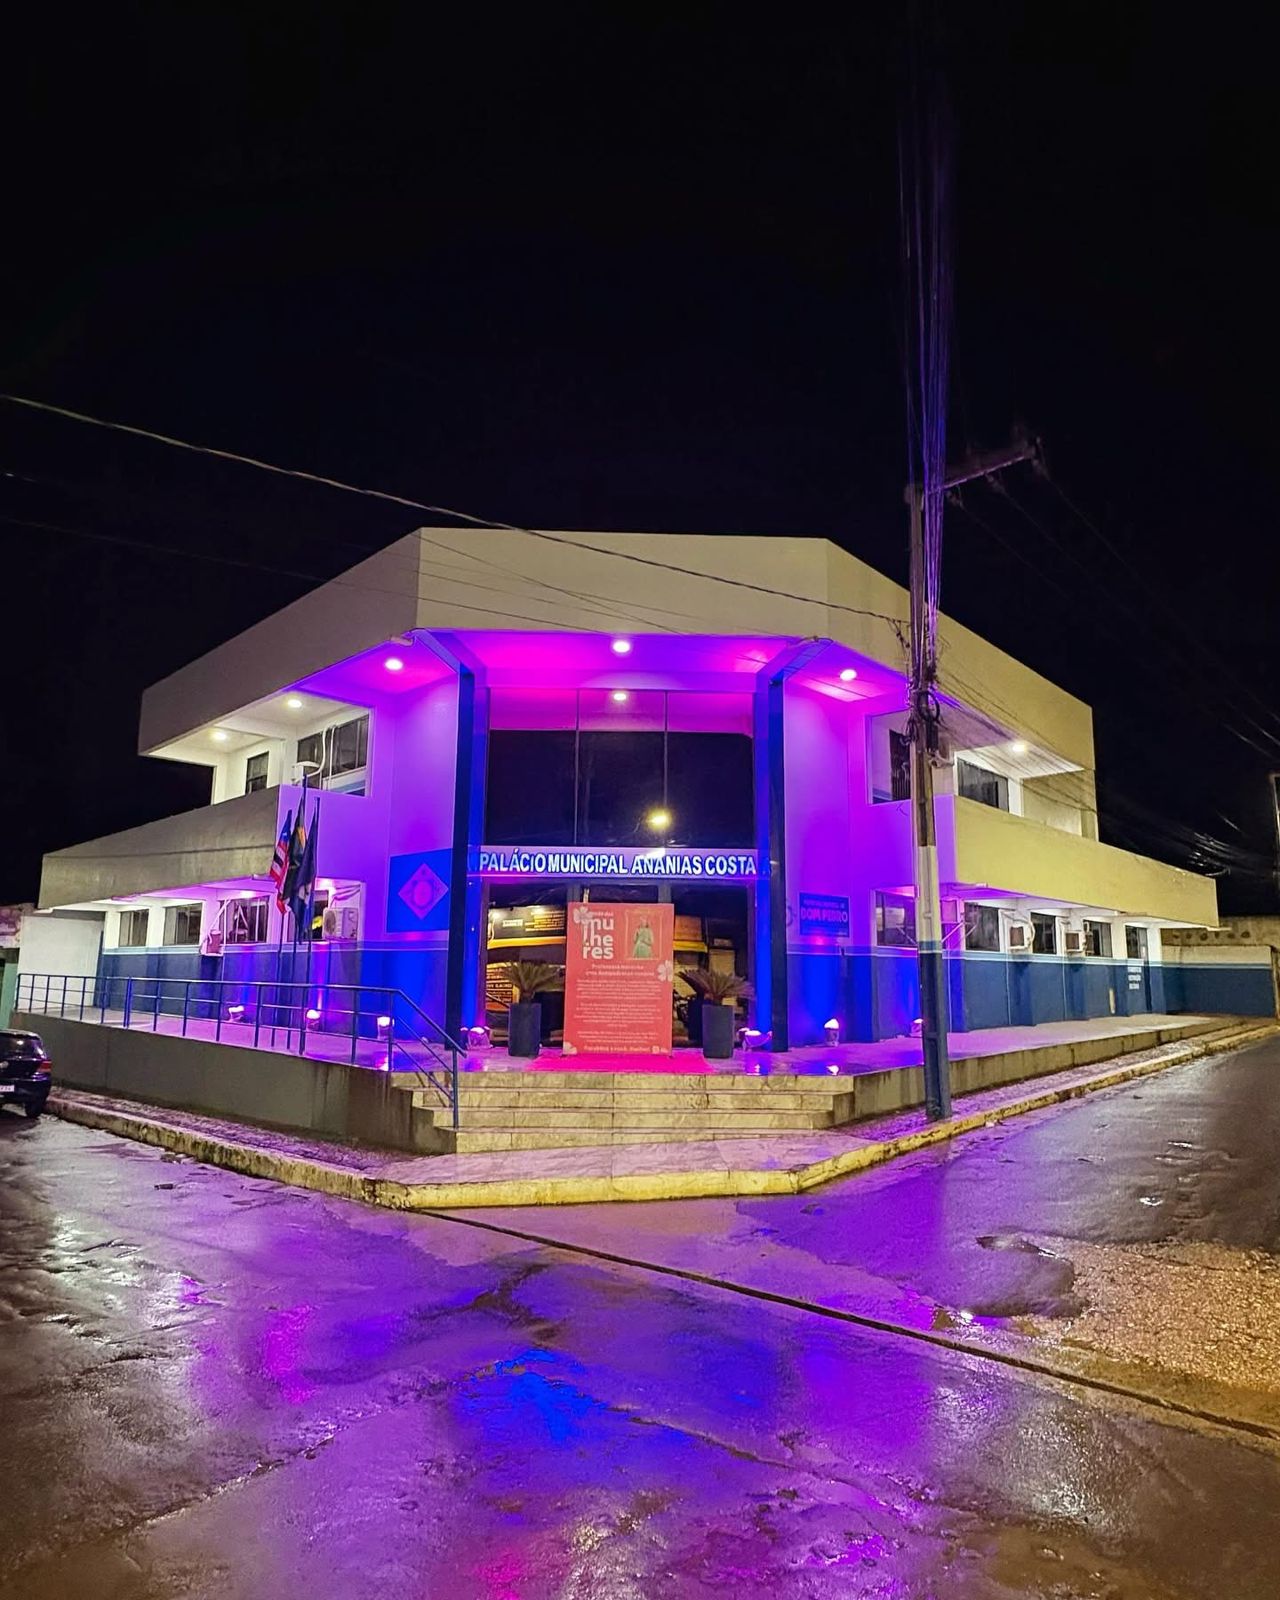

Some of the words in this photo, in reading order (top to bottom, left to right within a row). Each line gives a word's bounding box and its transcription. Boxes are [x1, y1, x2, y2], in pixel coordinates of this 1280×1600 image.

[479, 848, 546, 873] PALÁCIO
[547, 853, 628, 874] MUNICIPAL
[631, 855, 702, 875] ANANIAS
[704, 855, 758, 876] COSTA
[583, 946, 614, 960] res
